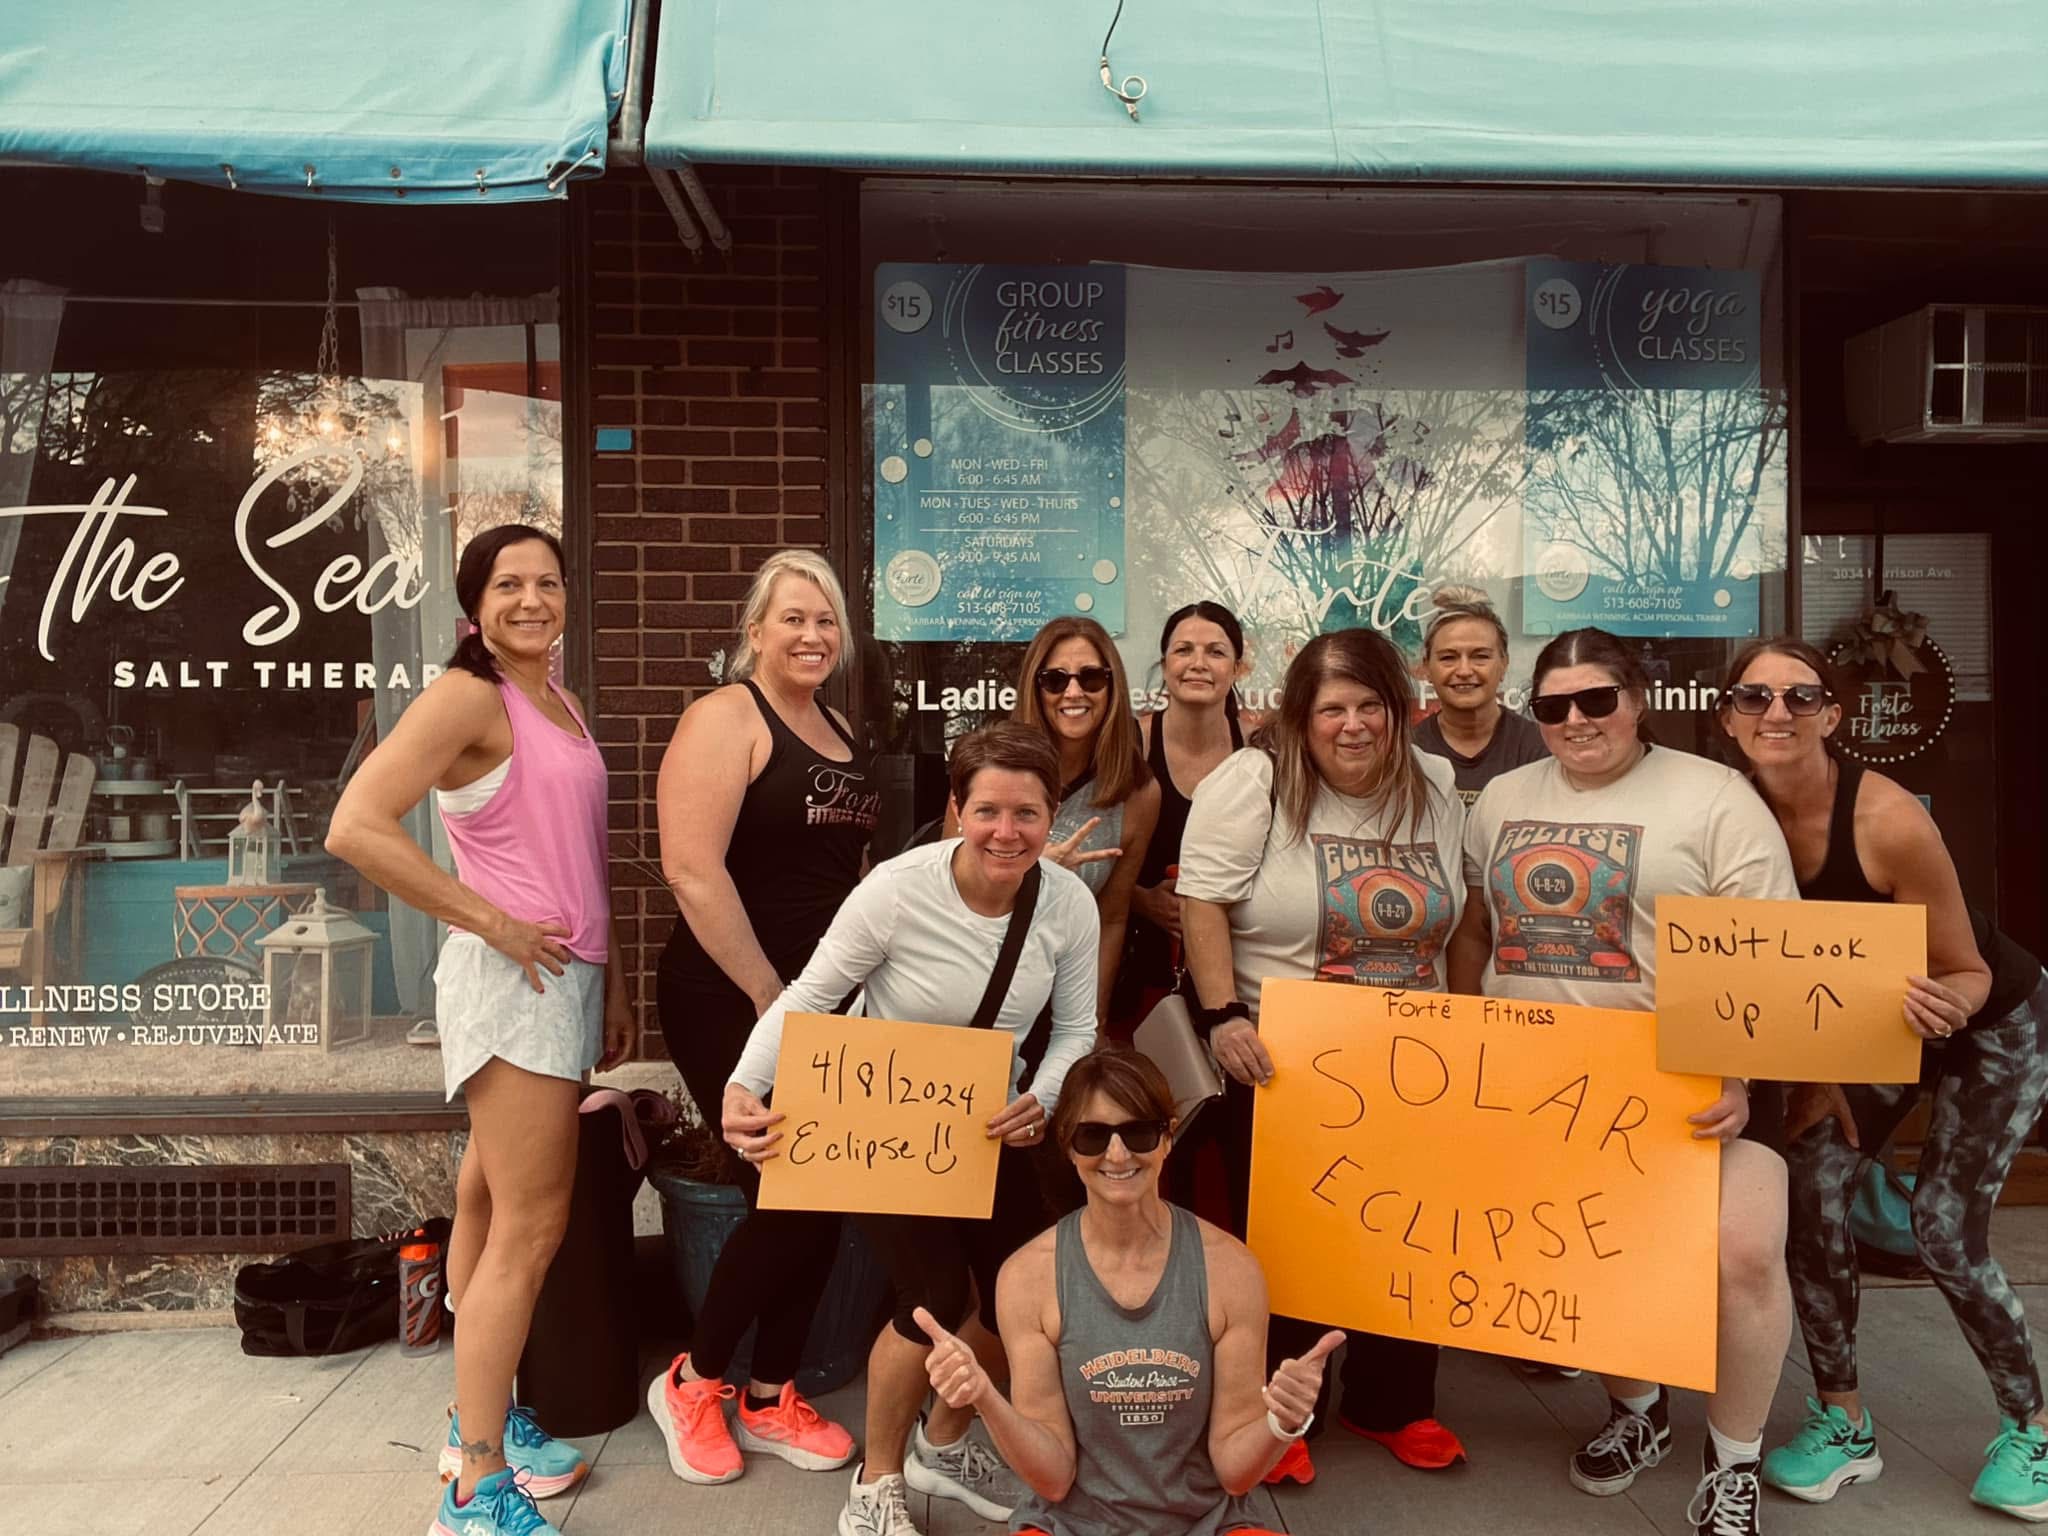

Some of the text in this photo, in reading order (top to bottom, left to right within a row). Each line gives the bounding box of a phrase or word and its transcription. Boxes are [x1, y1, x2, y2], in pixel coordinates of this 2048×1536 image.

[887, 294, 921, 318] $15
[996, 281, 1104, 309] GROUP
[1539, 292, 1571, 315] $15
[1637, 287, 1746, 335] yoga
[995, 309, 1104, 353] fitness
[1638, 336, 1746, 362] CLASSES
[996, 352, 1104, 375] CLASSES
[951, 459, 982, 471] MON
[991, 459, 1020, 471] WED
[1030, 459, 1048, 471] FRI
[958, 474, 983, 485] 6:00
[993, 474, 1018, 485] 6:45
[1021, 474, 1041, 485] AM
[920, 498, 951, 509] MON
[960, 498, 991, 509] TUES
[1000, 498, 1029, 509] WED
[1039, 498, 1079, 510] THURS
[958, 513, 983, 524] 6:00
[993, 513, 1018, 524] 6:45
[1021, 513, 1040, 524] PM
[0, 445, 430, 661] The Sea
[964, 536, 1034, 548] SATURDAYS
[1021, 552, 1041, 563] AM
[1867, 567, 1924, 579] rrison
[957, 603, 1041, 615] 513-608-7105
[1603, 597, 1682, 609] 513-608-7105
[1655, 614, 1694, 622] PERSONAL
[113, 661, 446, 689] SALT THERAP
[917, 680, 1017, 711] Ladie
[1850, 715, 1922, 739] Fitness
[1494, 826, 1630, 867] ECLIPSE
[1534, 877, 1566, 893] 4-8-24
[0, 983, 271, 1013] LLNESS STORE
[1483, 999, 1555, 1026] Fitness
[9, 1023, 318, 1048] RENEW REJUVENATE
[811, 1043, 975, 1115] 4/8/2024
[1312, 1035, 1649, 1175] SOLAR
[789, 1120, 916, 1169] Eclipse
[1311, 1155, 1623, 1262] ECLIPSE
[1079, 1348, 1201, 1381] HEIDELBERG
[1105, 1370, 1145, 1388] Student
[1090, 1387, 1195, 1404] UNIVERSITY
[1125, 1415, 1159, 1423] 1850
